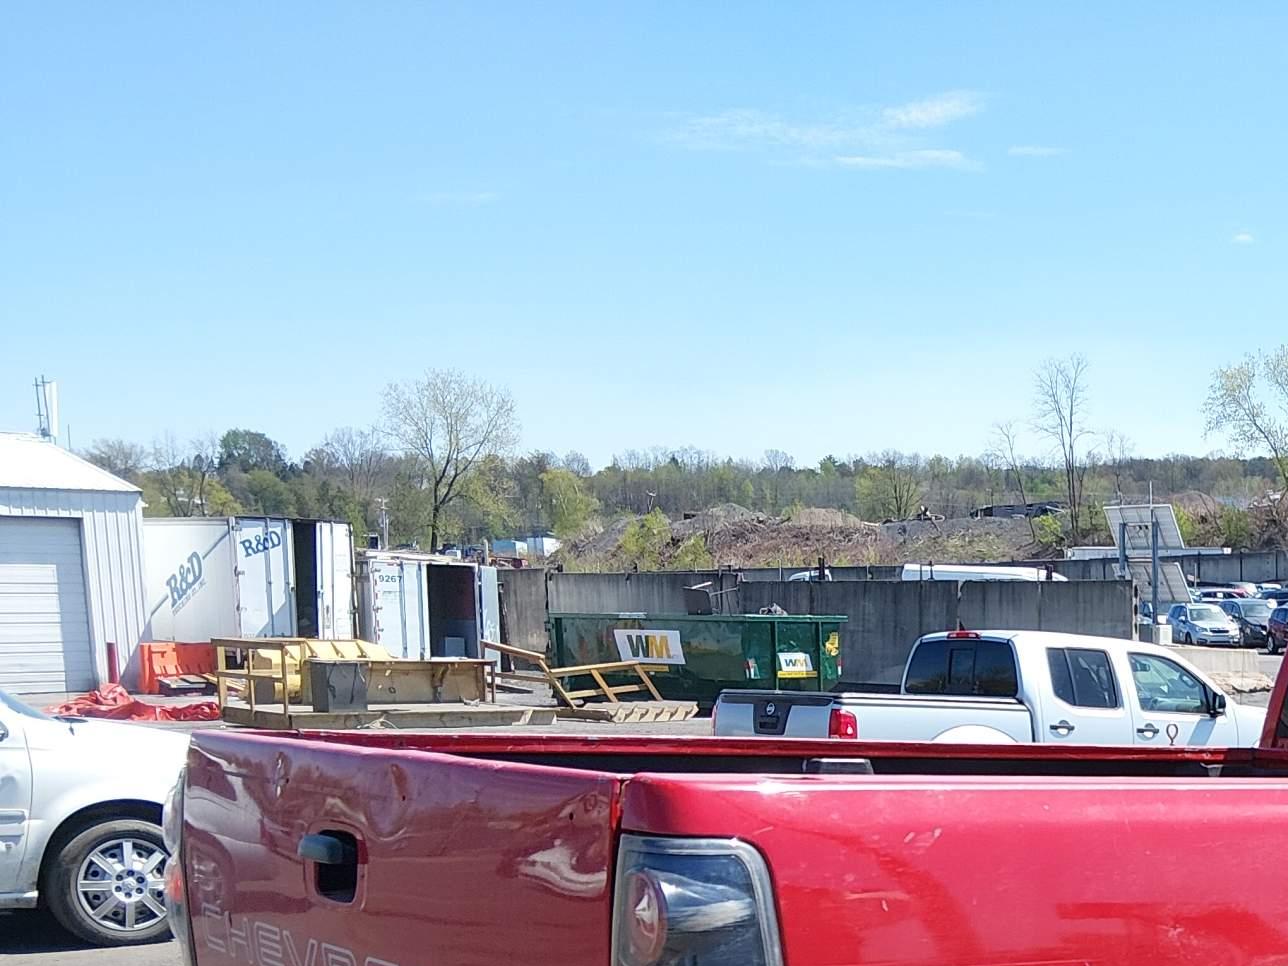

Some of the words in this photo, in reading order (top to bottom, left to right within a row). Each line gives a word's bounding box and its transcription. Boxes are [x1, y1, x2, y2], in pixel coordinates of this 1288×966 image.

[240, 530, 281, 558] R&D
[166, 551, 203, 609] R&D
[379, 574, 402, 583] 9267
[626, 633, 672, 659] WM
